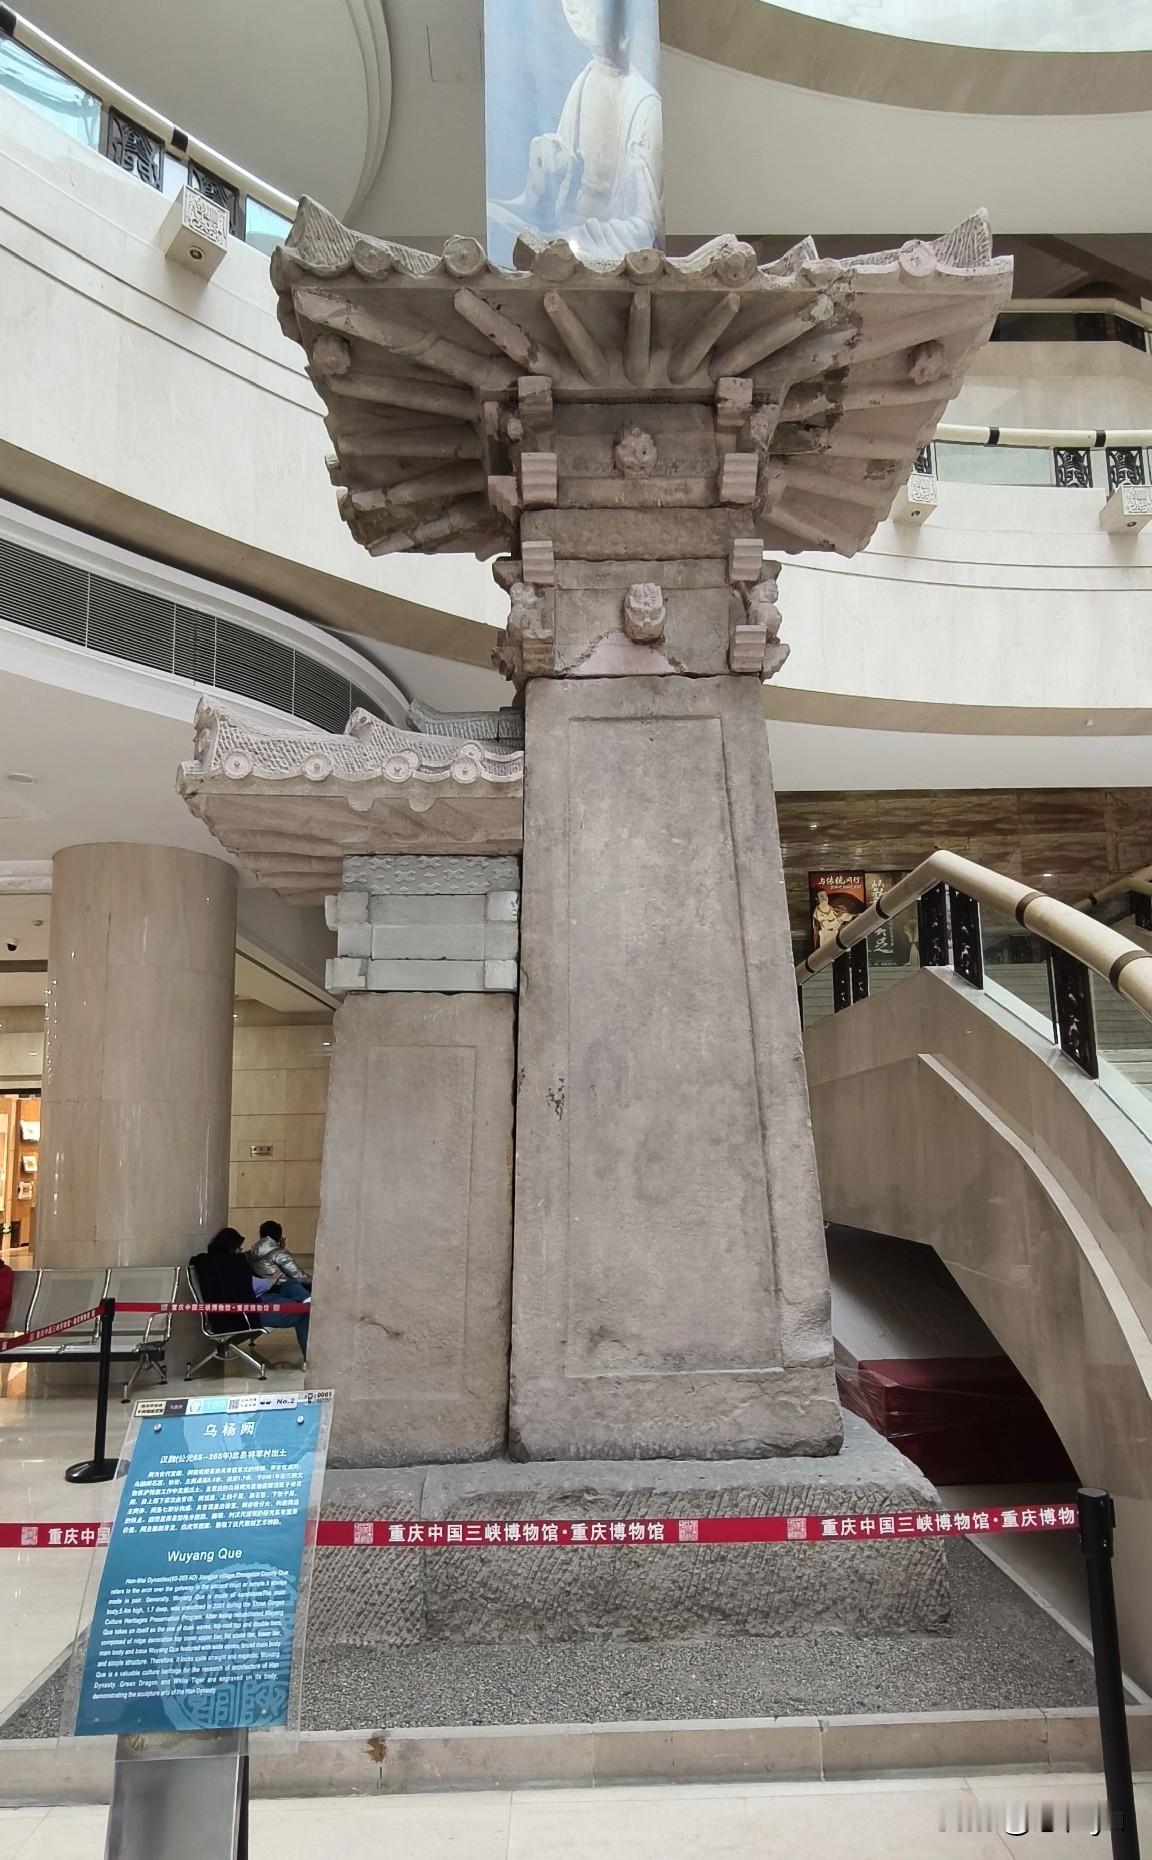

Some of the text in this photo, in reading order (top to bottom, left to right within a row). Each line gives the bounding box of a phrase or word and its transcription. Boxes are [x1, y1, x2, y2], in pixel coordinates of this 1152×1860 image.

[203, 1421, 256, 1437] 乌杨阙
[167, 1548, 242, 1563] Wuyang Que
